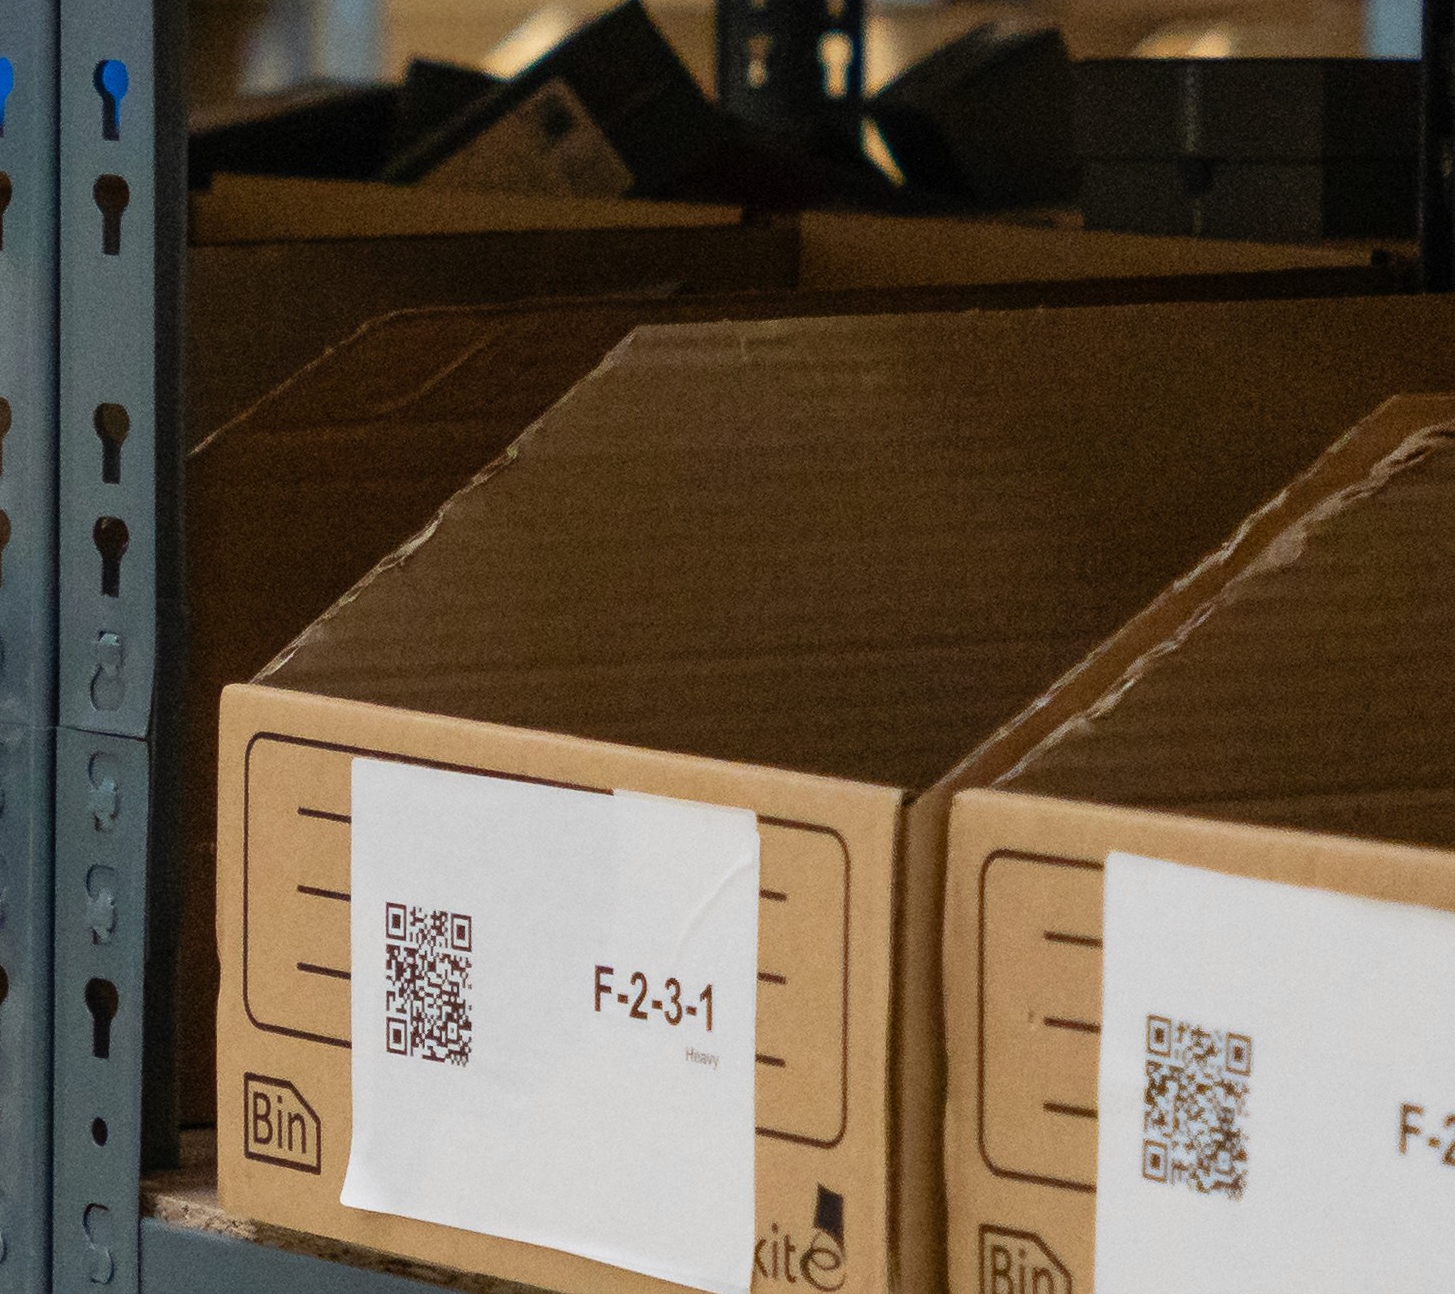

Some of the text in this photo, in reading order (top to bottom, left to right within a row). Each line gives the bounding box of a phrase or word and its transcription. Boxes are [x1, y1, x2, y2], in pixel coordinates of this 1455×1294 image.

[594, 964, 714, 1032] F-2-3-1
[684, 1045, 720, 1069] Heavy
[253, 1089, 307, 1155] Bin
